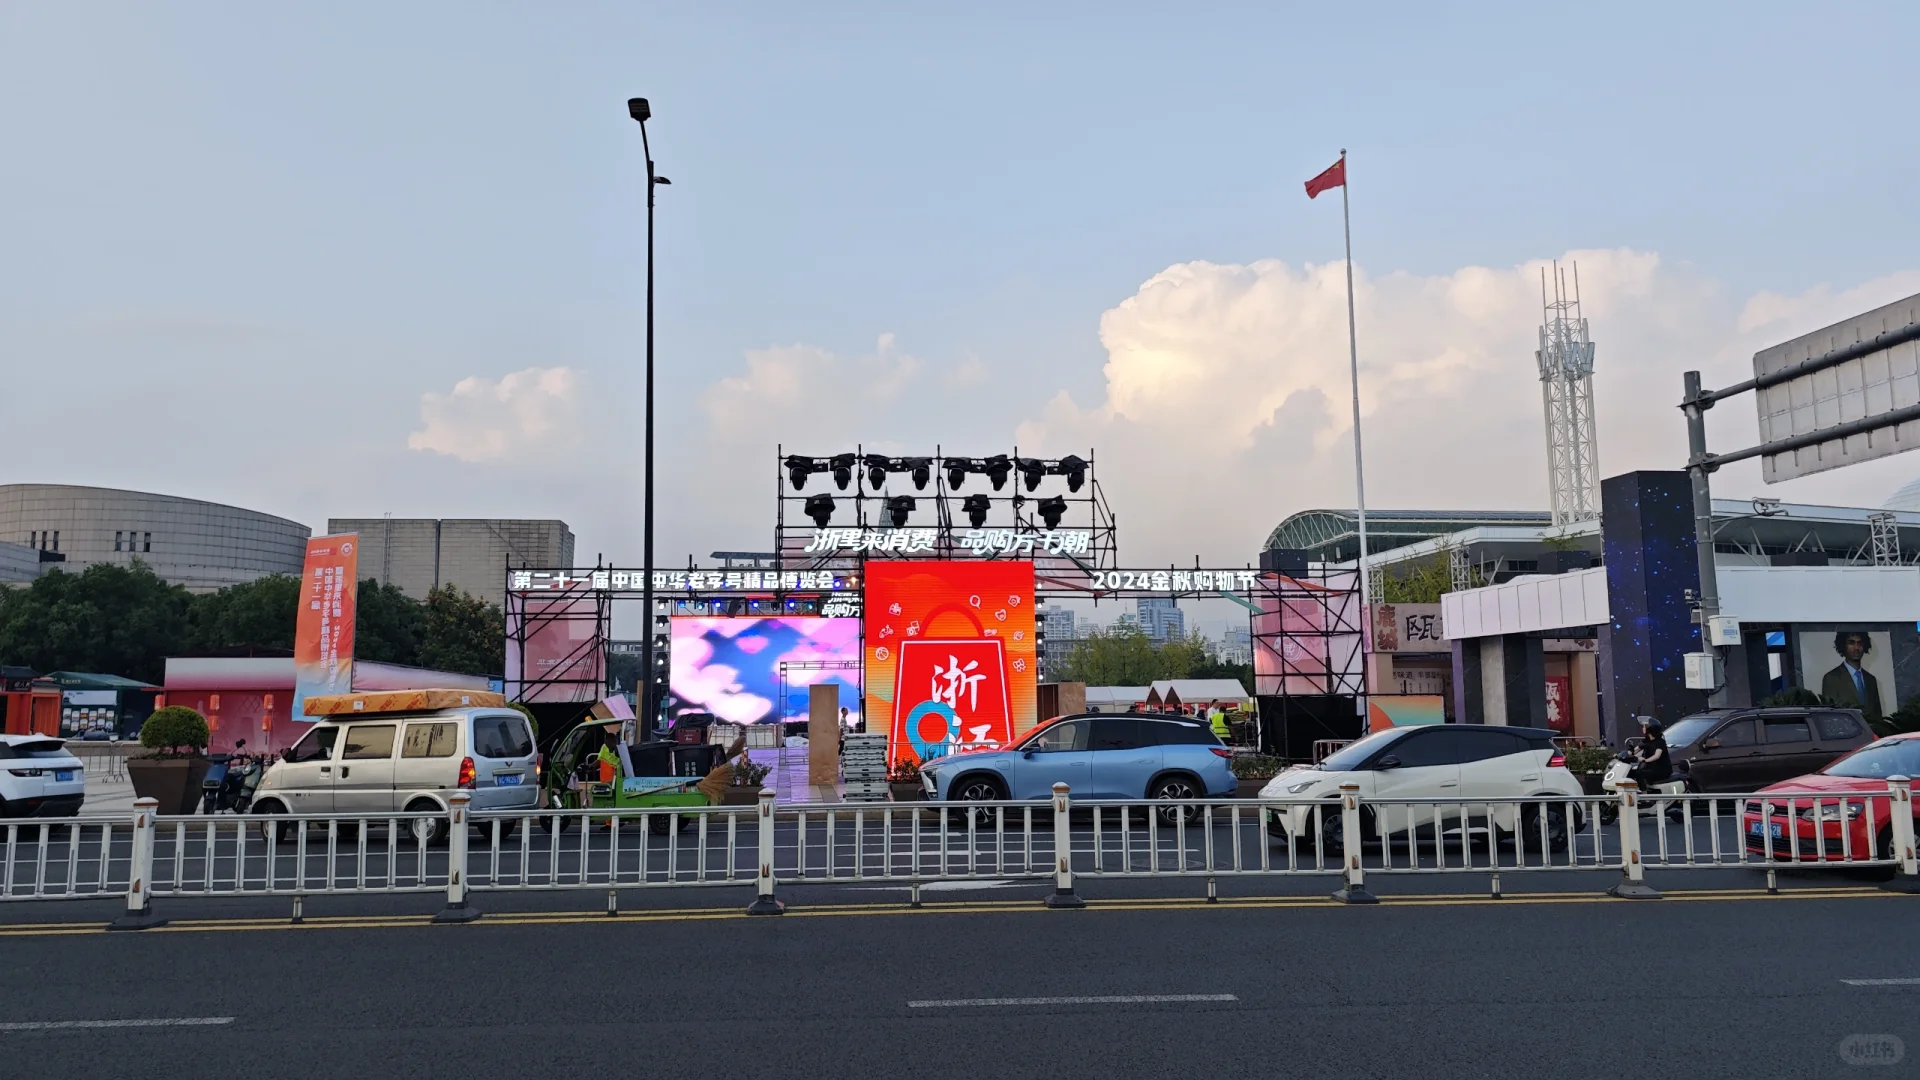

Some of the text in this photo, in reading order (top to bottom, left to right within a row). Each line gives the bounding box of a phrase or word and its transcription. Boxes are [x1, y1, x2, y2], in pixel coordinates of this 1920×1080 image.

[804, 528, 1090, 555] 浙里来消费 品购万千潮
[514, 571, 834, 589] 第二十一届中国中华老字号精品博览会
[1093, 571, 1256, 591] 2024金秋购物节
[1376, 604, 1398, 651] 鹿城
